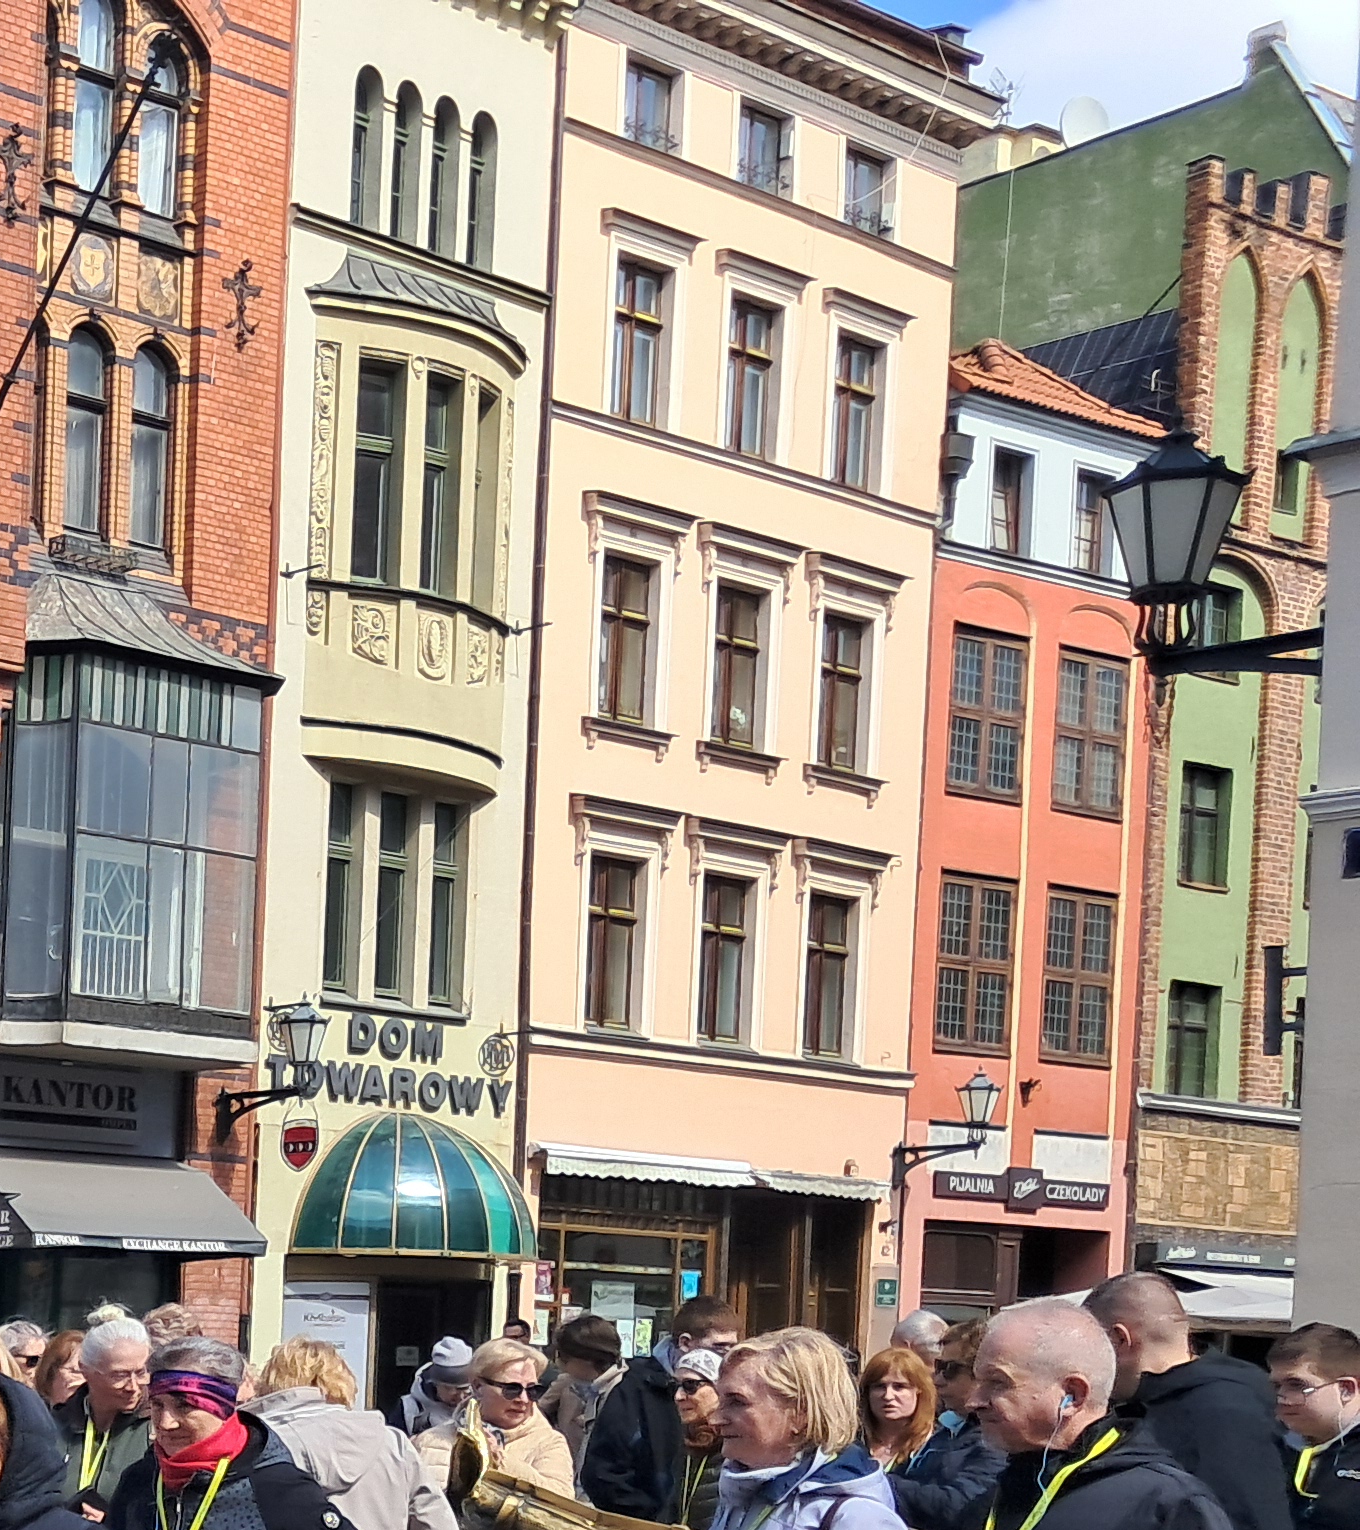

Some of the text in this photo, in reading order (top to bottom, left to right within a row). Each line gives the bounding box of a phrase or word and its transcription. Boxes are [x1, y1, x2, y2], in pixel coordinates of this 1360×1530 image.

[347, 1013, 444, 1066] DOM
[3, 1075, 138, 1114] KANTOR
[265, 1053, 513, 1118] TOWAROWY
[949, 1176, 995, 1195] PIJALNIA
[1045, 1183, 1106, 1203] CZEKOLADY
